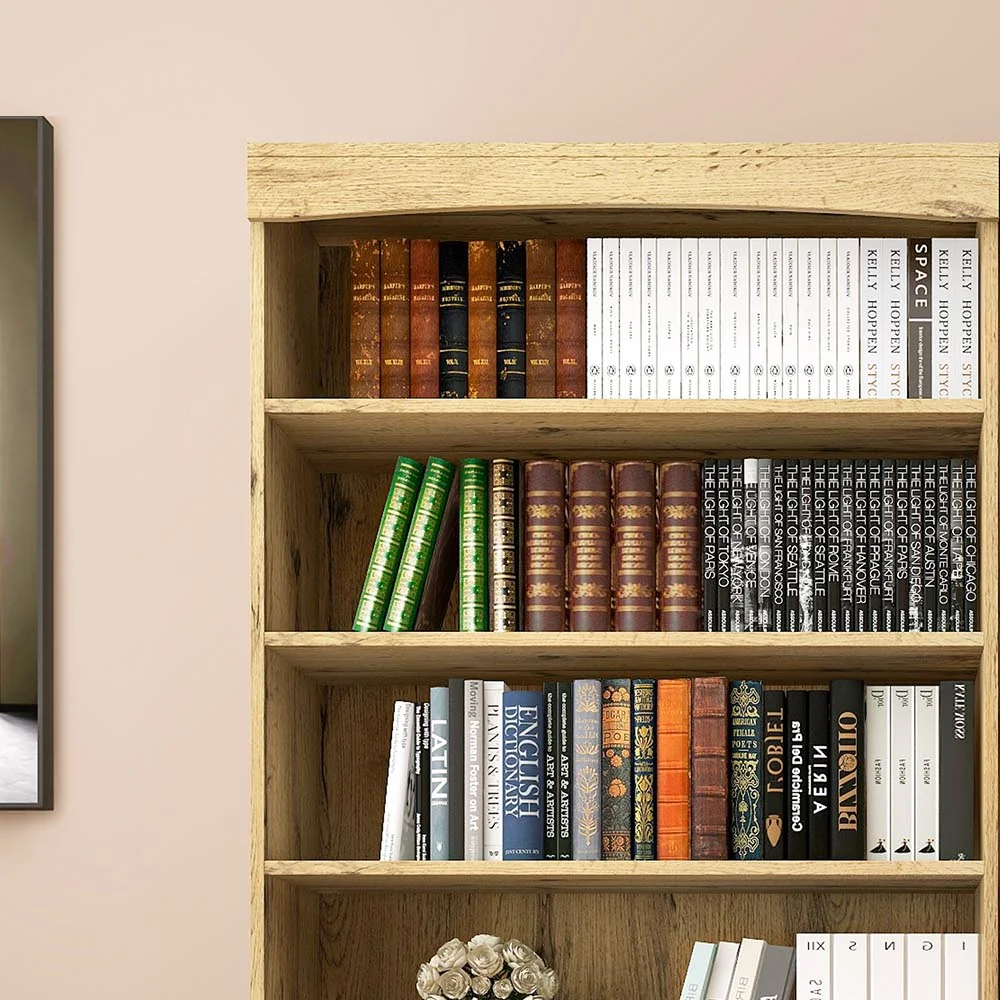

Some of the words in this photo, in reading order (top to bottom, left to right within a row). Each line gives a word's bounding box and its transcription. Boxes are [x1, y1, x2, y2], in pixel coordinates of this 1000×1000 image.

[867, 249, 878, 290] KELLY
[914, 244, 928, 308] SPACE
[938, 249, 949, 290] KELLY
[962, 249, 972, 290] KELLY
[867, 300, 878, 354] HOPPEN
[938, 300, 949, 354] HOPPEN
[962, 300, 972, 354] HOPPEN
[704, 465, 716, 488] THE
[786, 465, 798, 488] THE
[828, 465, 839, 488] THE
[965, 465, 976, 488] THE
[704, 490, 716, 525] LIGHT
[786, 490, 798, 525] LIGHT
[828, 490, 839, 525] LIGHT
[965, 490, 976, 525] LIGHT
[704, 526, 716, 542] OF
[786, 526, 798, 542] OF
[828, 526, 839, 542] OF
[965, 526, 976, 542] OF
[704, 545, 716, 580] PARIS
[786, 545, 798, 597] SEATTLE
[828, 545, 839, 582] ROME
[965, 545, 976, 602] CHICAGO
[468, 681, 478, 718] Moving
[470, 720, 480, 762] Norman
[487, 704, 499, 763] PLANTS
[604, 732, 630, 742] POE
[732, 740, 758, 748] POETS
[504, 706, 519, 818] DICTIONARY
[518, 705, 540, 818] ENGLISH
[546, 754, 556, 778] ART
[560, 754, 570, 778] ART
[470, 764, 480, 795] Foster
[470, 800, 478, 812] on
[470, 814, 480, 832] Art
[487, 784, 499, 830] TREES
[546, 791, 556, 838] ARTISTS
[560, 791, 570, 838] ARTISTS
